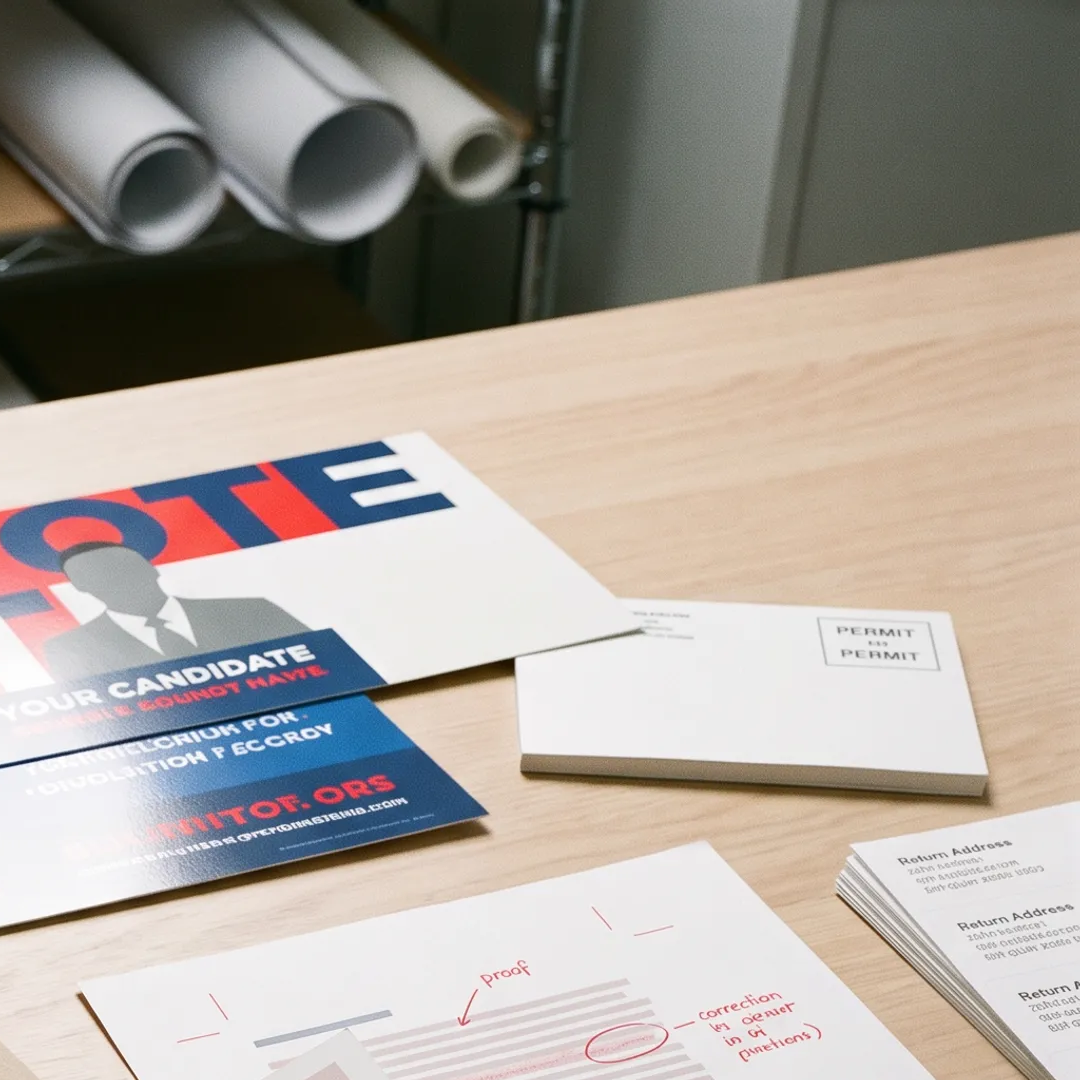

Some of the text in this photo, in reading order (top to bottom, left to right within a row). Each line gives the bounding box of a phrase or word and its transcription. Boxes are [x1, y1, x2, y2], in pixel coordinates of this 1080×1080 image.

[837, 625, 916, 639] PERMIT
[841, 648, 920, 662] PERMIT
[107, 644, 316, 700] CANDIDATE
[480, 959, 531, 989] proof
[1018, 984, 1072, 1001] Return
